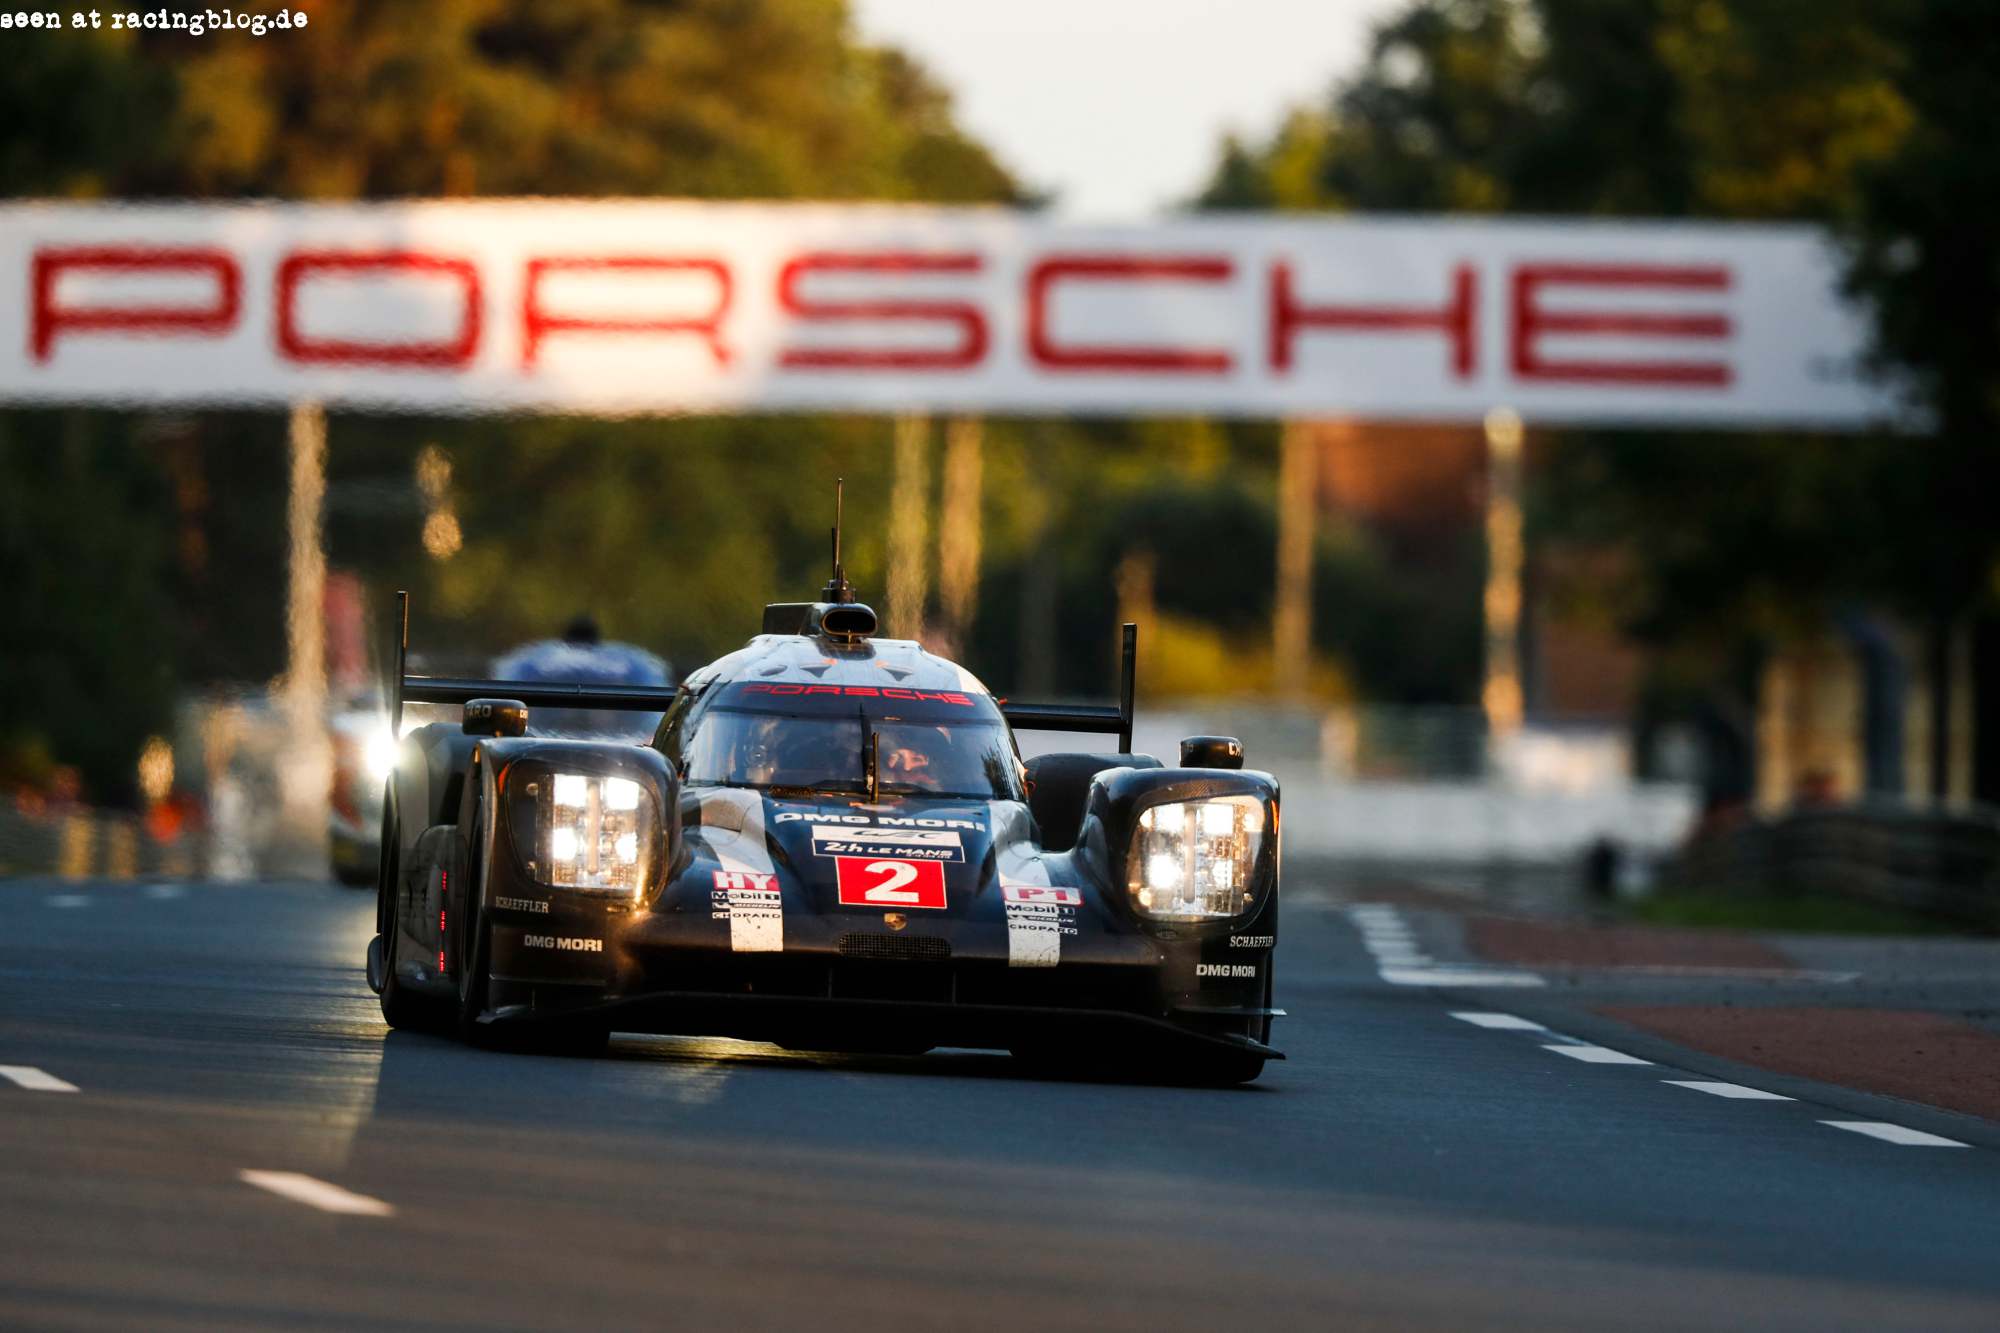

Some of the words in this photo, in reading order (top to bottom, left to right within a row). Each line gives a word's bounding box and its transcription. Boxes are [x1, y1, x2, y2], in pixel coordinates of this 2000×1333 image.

[30, 244, 1735, 386] PORSCHE
[742, 684, 976, 706] PORSCHE
[774, 813, 870, 824] DMG
[878, 816, 986, 832] MORI
[867, 846, 890, 854] LE
[895, 848, 953, 856] MANS
[715, 871, 775, 889] HY
[864, 860, 920, 903] 2
[713, 892, 761, 900] Mobil
[1017, 888, 1068, 901] P1
[1006, 905, 1056, 914] Mobil
[1009, 924, 1078, 935] CHOPARD
[524, 934, 555, 949] DMG
[556, 937, 603, 952] MORI
[1195, 963, 1231, 977] DMG
[1231, 965, 1256, 978] MORI
